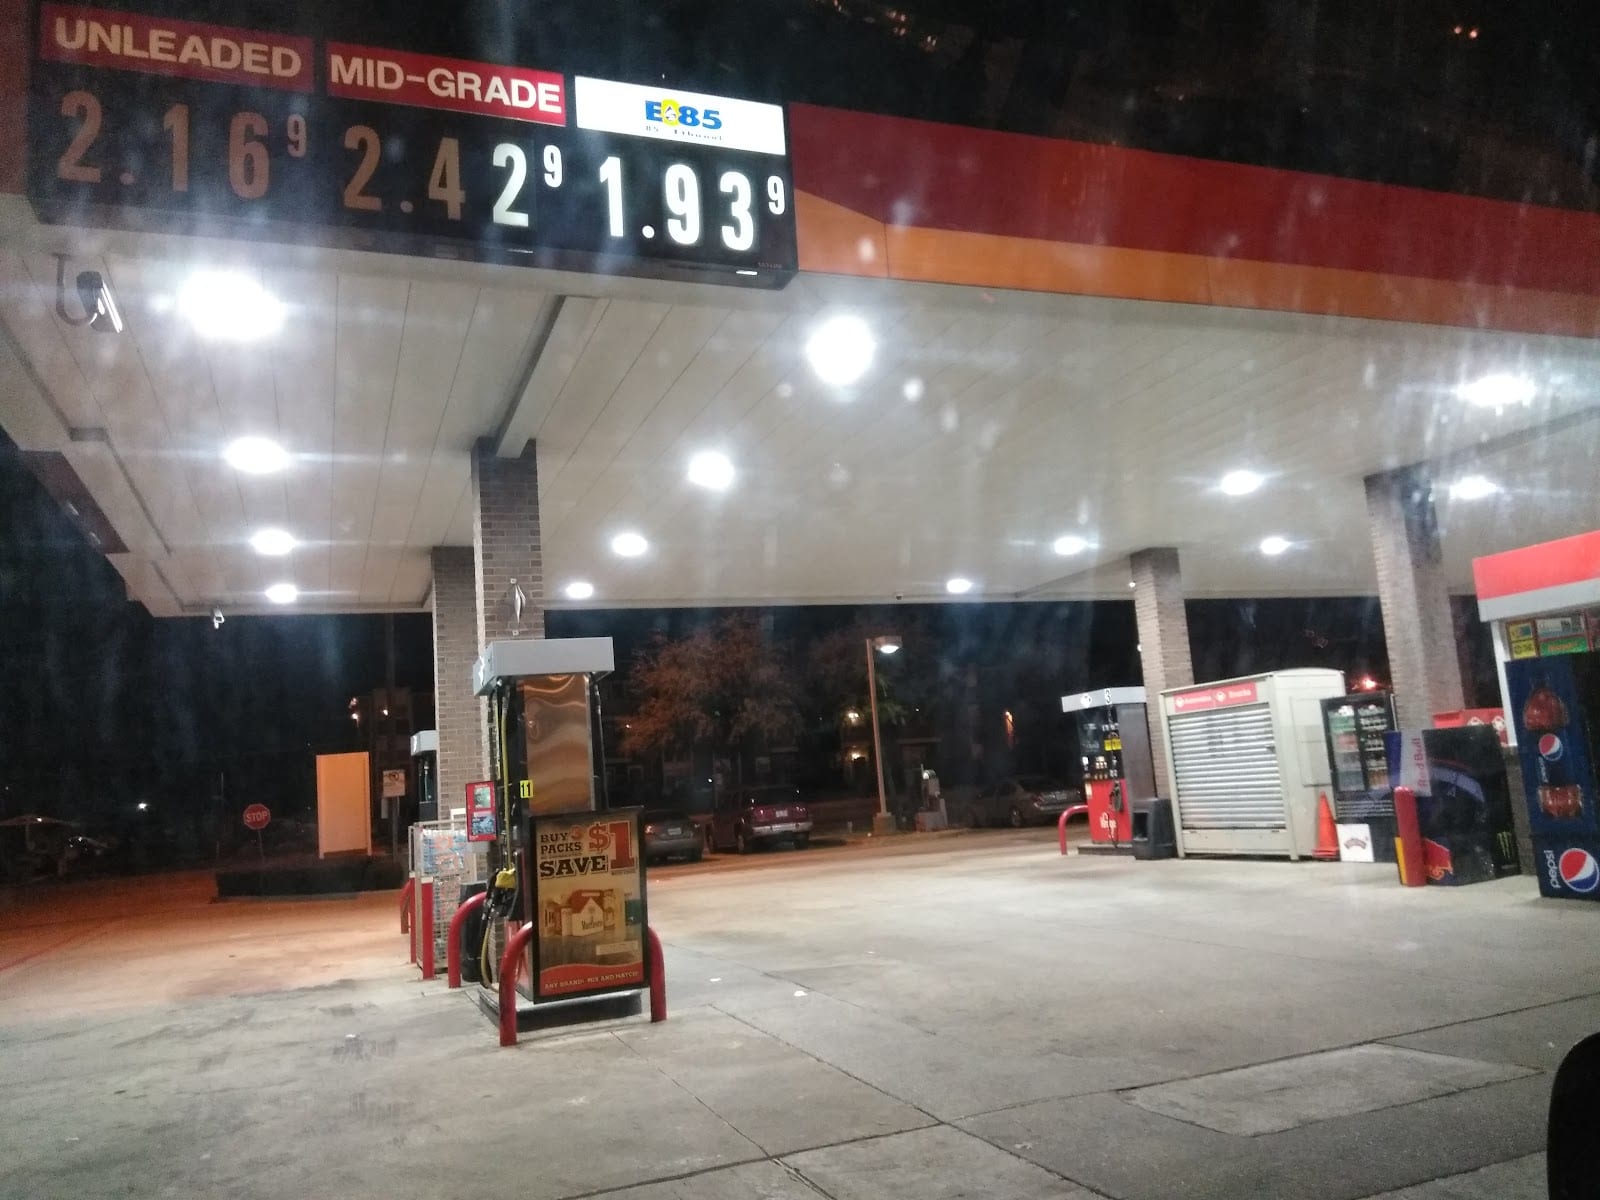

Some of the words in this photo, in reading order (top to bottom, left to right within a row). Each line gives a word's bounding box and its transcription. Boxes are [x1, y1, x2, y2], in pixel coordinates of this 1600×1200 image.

[54, 17, 301, 77] UNLEADED
[330, 54, 563, 113] MID-GRADE
[521, 782, 531, 797] 11
[246, 810, 268, 823] STOP
[540, 832, 568, 843] BUY
[570, 825, 583, 840] 3
[540, 841, 582, 855] PACKS
[540, 855, 608, 878] SAVE
[1544, 850, 1561, 889] pepsi
